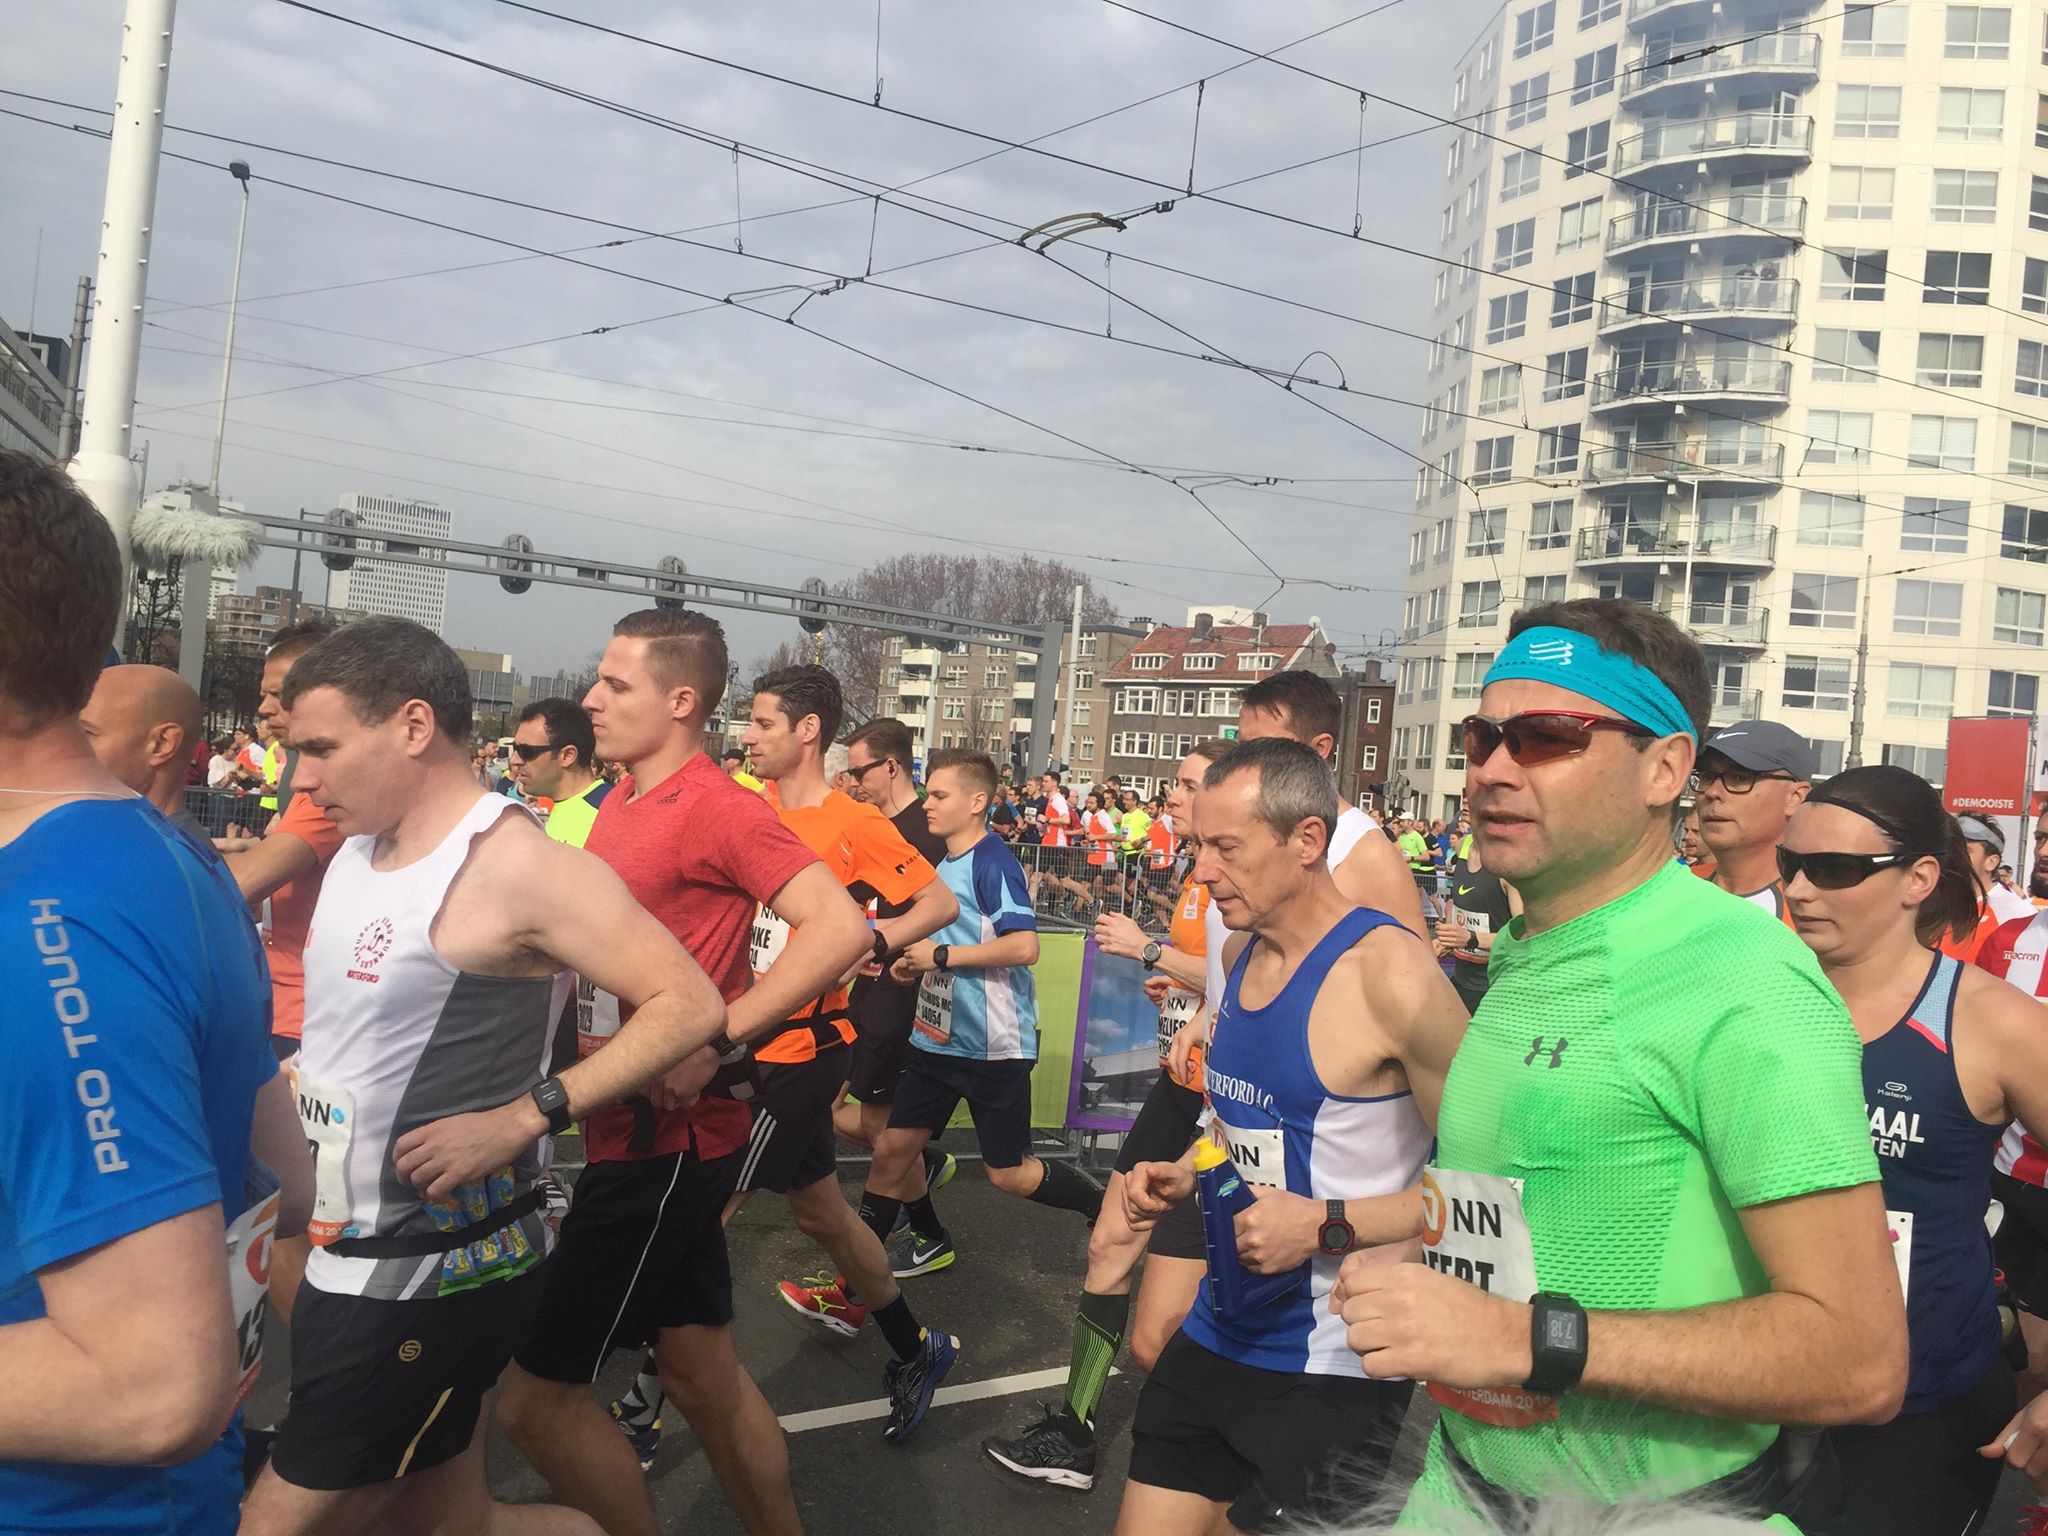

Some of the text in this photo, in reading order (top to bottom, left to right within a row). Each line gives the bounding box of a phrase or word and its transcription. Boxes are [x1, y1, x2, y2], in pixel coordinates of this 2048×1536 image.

[1952, 797, 2015, 810] #DEMOOISTE
[2003, 951, 2040, 962] macron
[29, 898, 129, 1174] PRO TOUCH
[299, 1093, 331, 1126] NN
[1228, 1141, 1260, 1168] NN
[1451, 1197, 1502, 1239] NN
